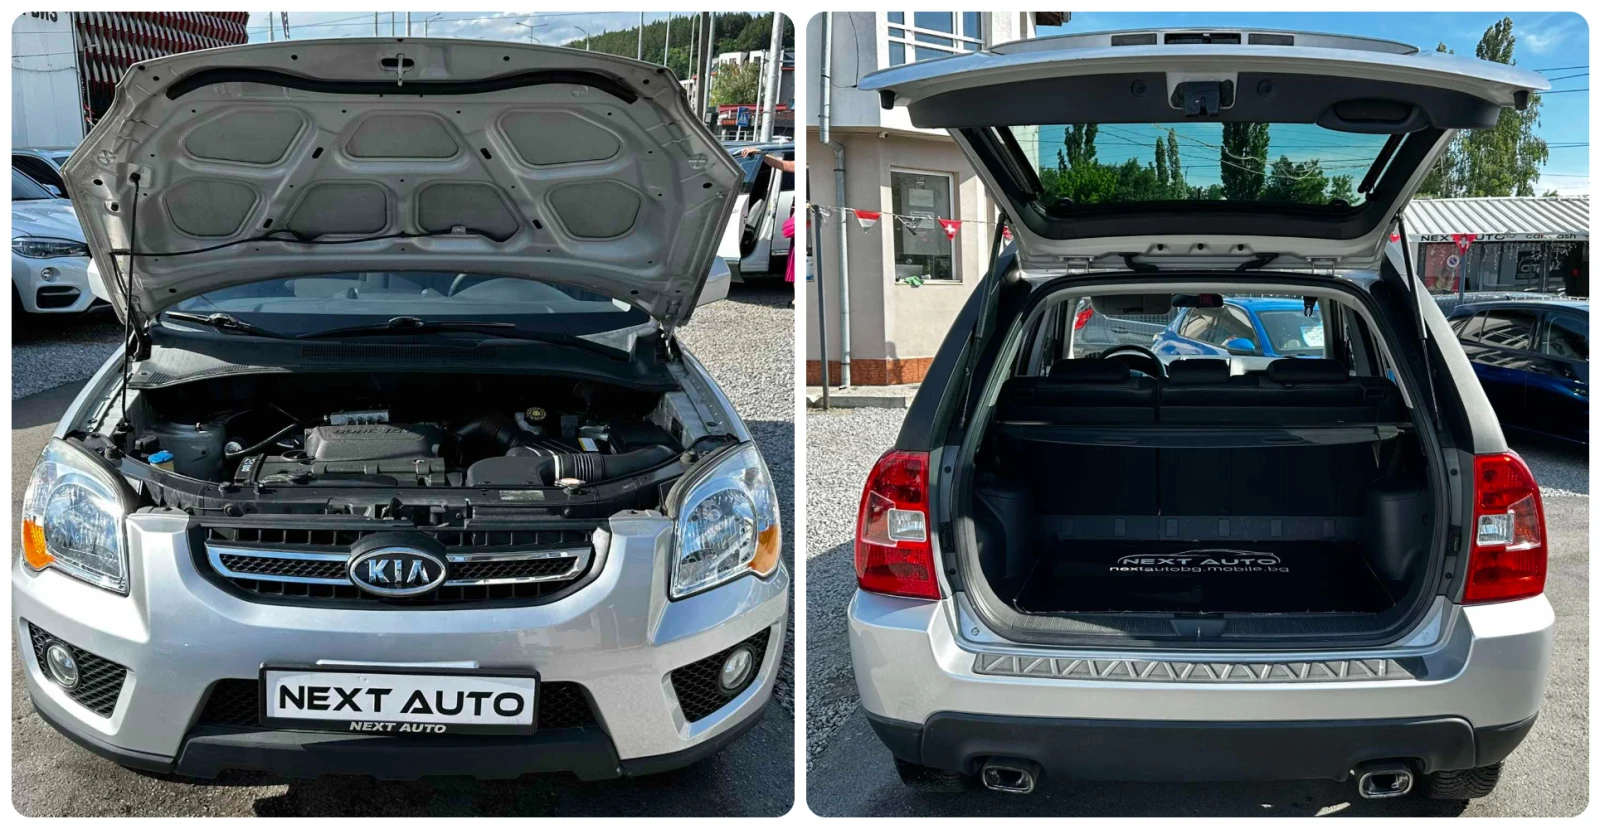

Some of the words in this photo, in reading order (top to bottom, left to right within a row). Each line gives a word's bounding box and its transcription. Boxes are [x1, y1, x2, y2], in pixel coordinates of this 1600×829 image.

[1474, 233, 1505, 241] UTO
[368, 559, 430, 583] KIA
[1109, 565, 1290, 573] nextautobg.mobile.bg
[279, 685, 393, 713] NEXT
[399, 689, 525, 717] AUTO
[350, 721, 396, 732] NEXT
[399, 722, 447, 734] AUTO
